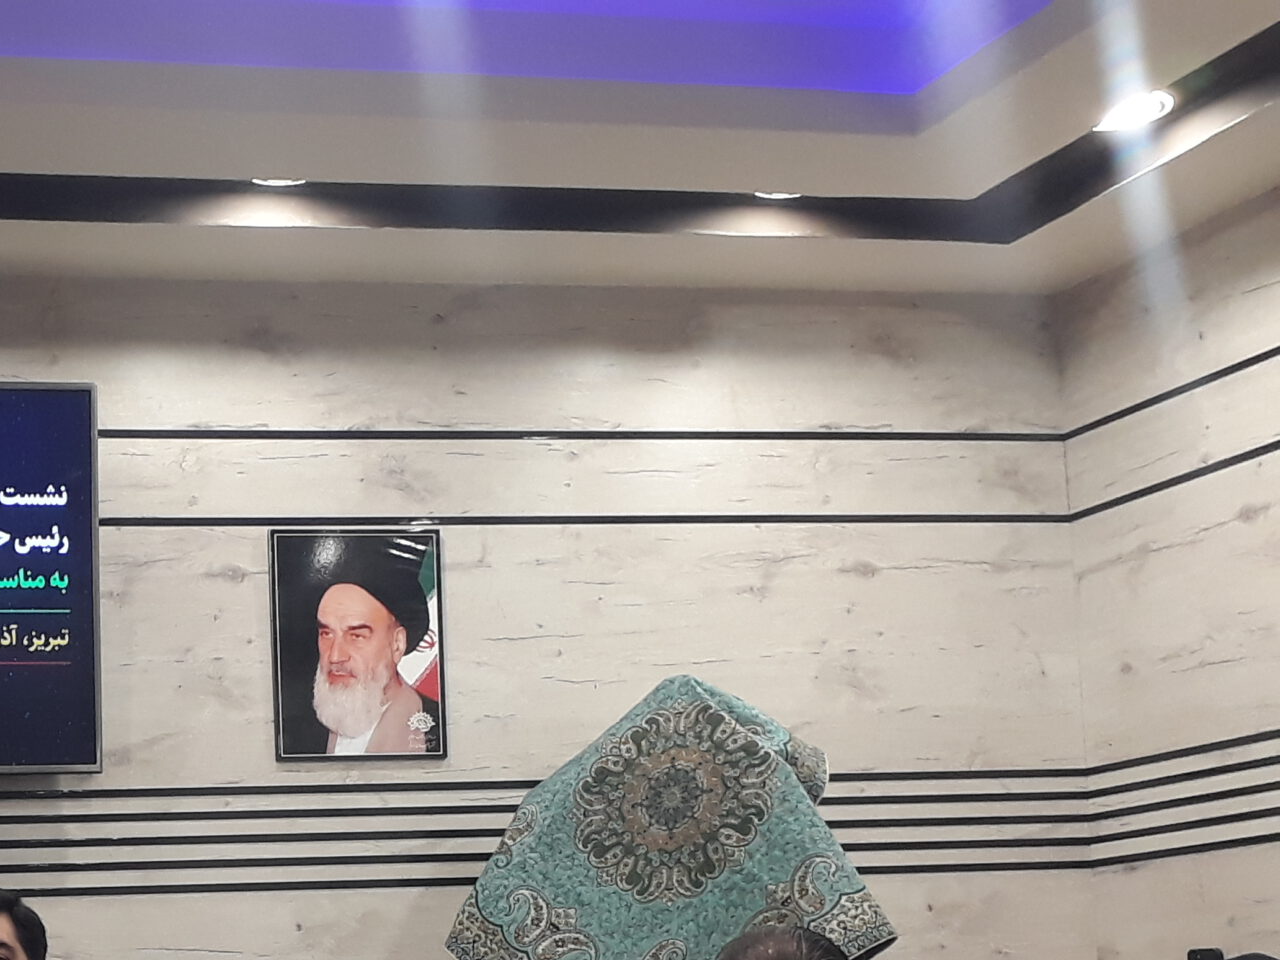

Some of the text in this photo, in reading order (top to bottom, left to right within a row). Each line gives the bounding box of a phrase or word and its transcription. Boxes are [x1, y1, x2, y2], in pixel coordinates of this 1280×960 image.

[0, 484, 68, 506] نشست
[14, 525, 69, 554] رئیس
[49, 570, 69, 594] به
[23, 628, 70, 652] تبریز،
